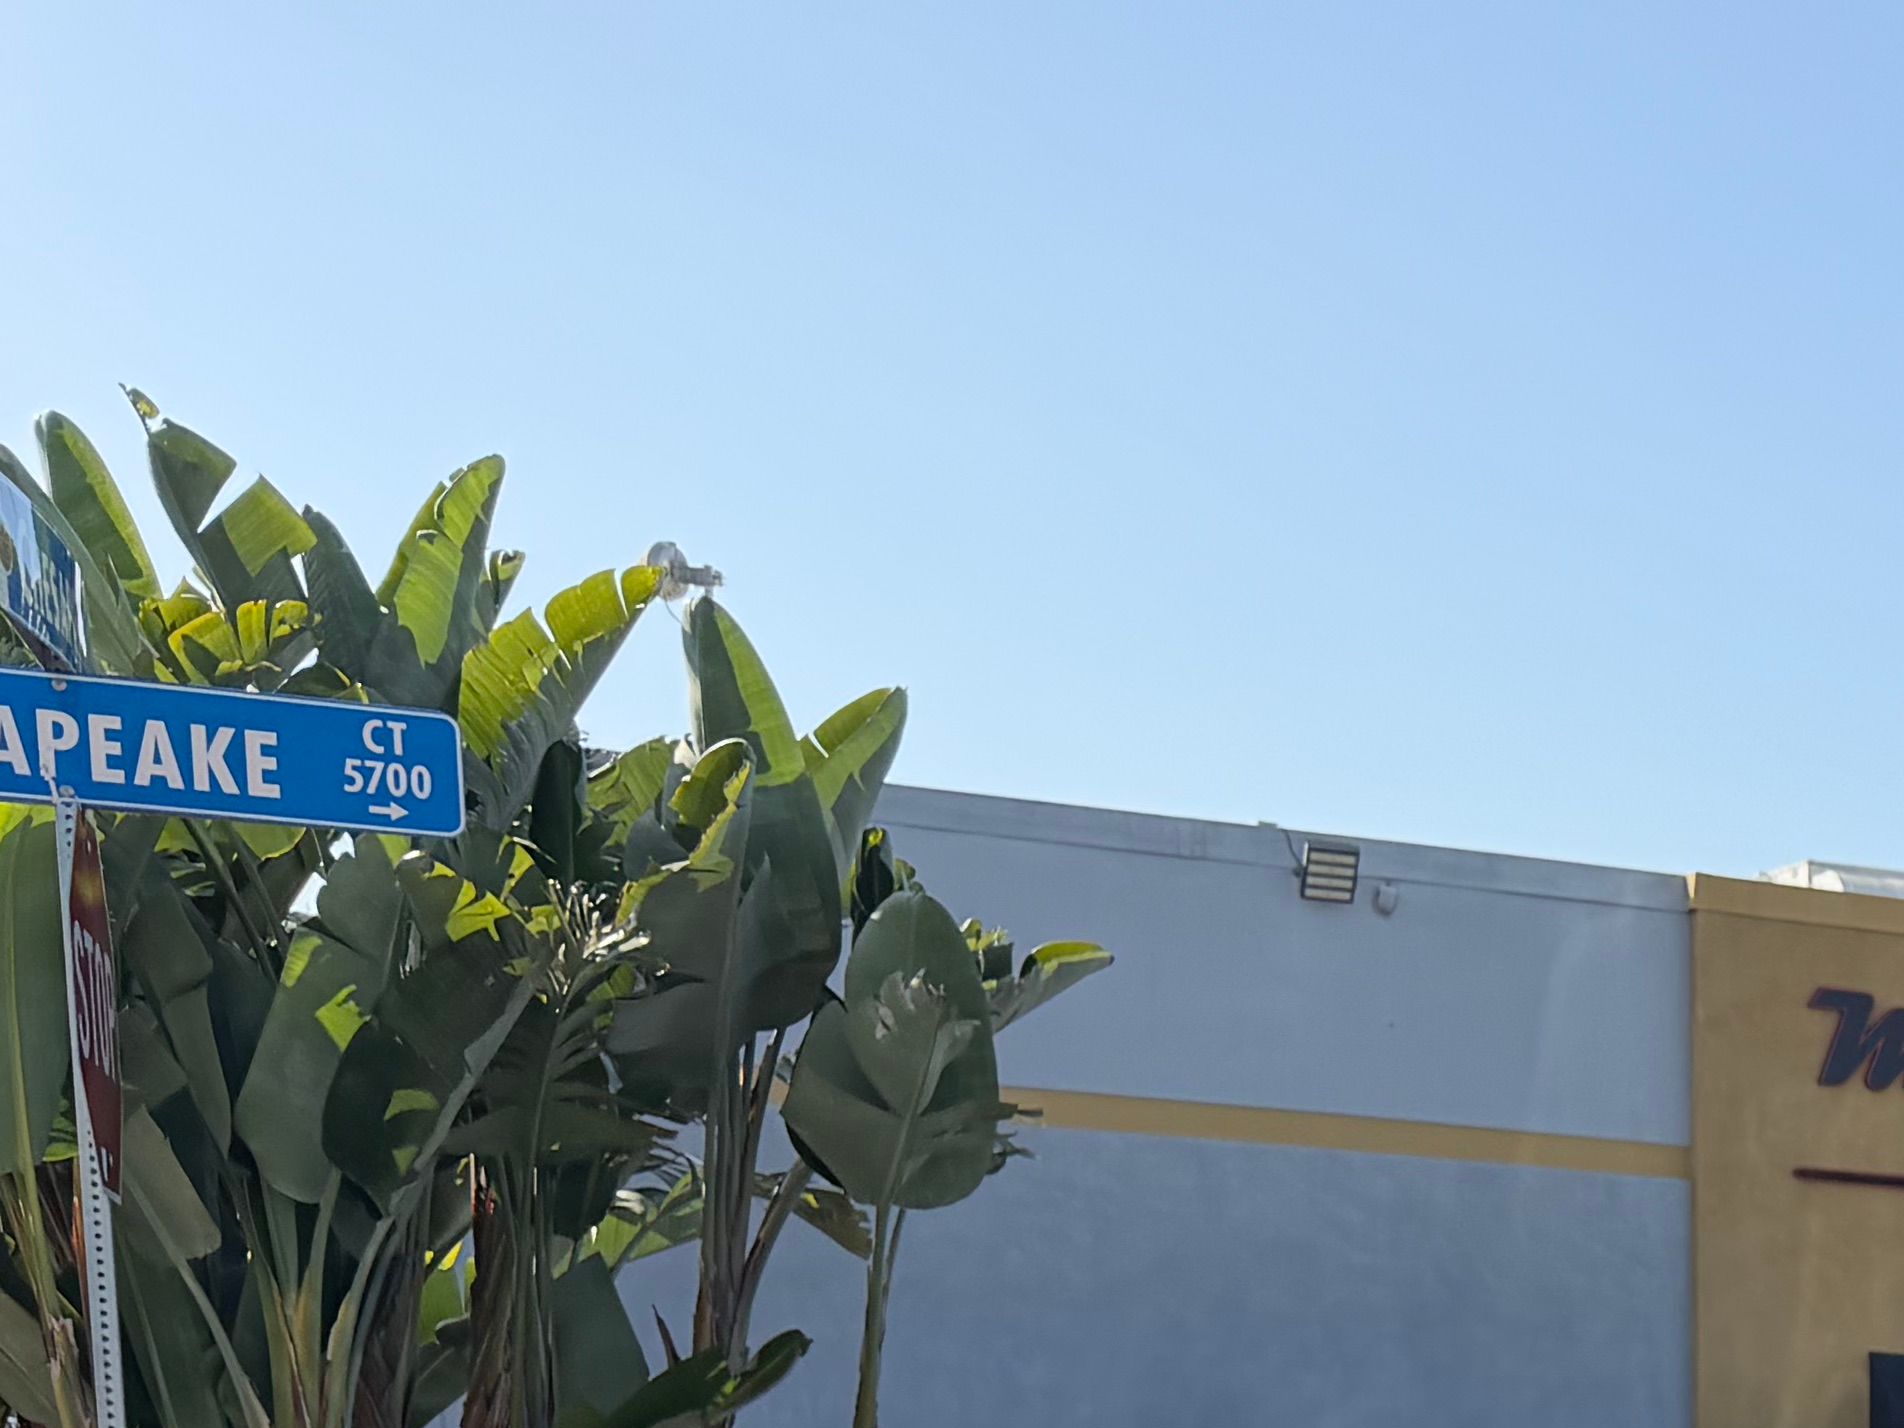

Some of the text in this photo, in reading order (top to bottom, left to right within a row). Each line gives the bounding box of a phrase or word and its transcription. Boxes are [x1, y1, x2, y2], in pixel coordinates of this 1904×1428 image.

[0, 704, 281, 799] APEAKE
[362, 719, 407, 755] CT
[344, 758, 432, 800] 5700
[73, 919, 116, 1083] STOP
